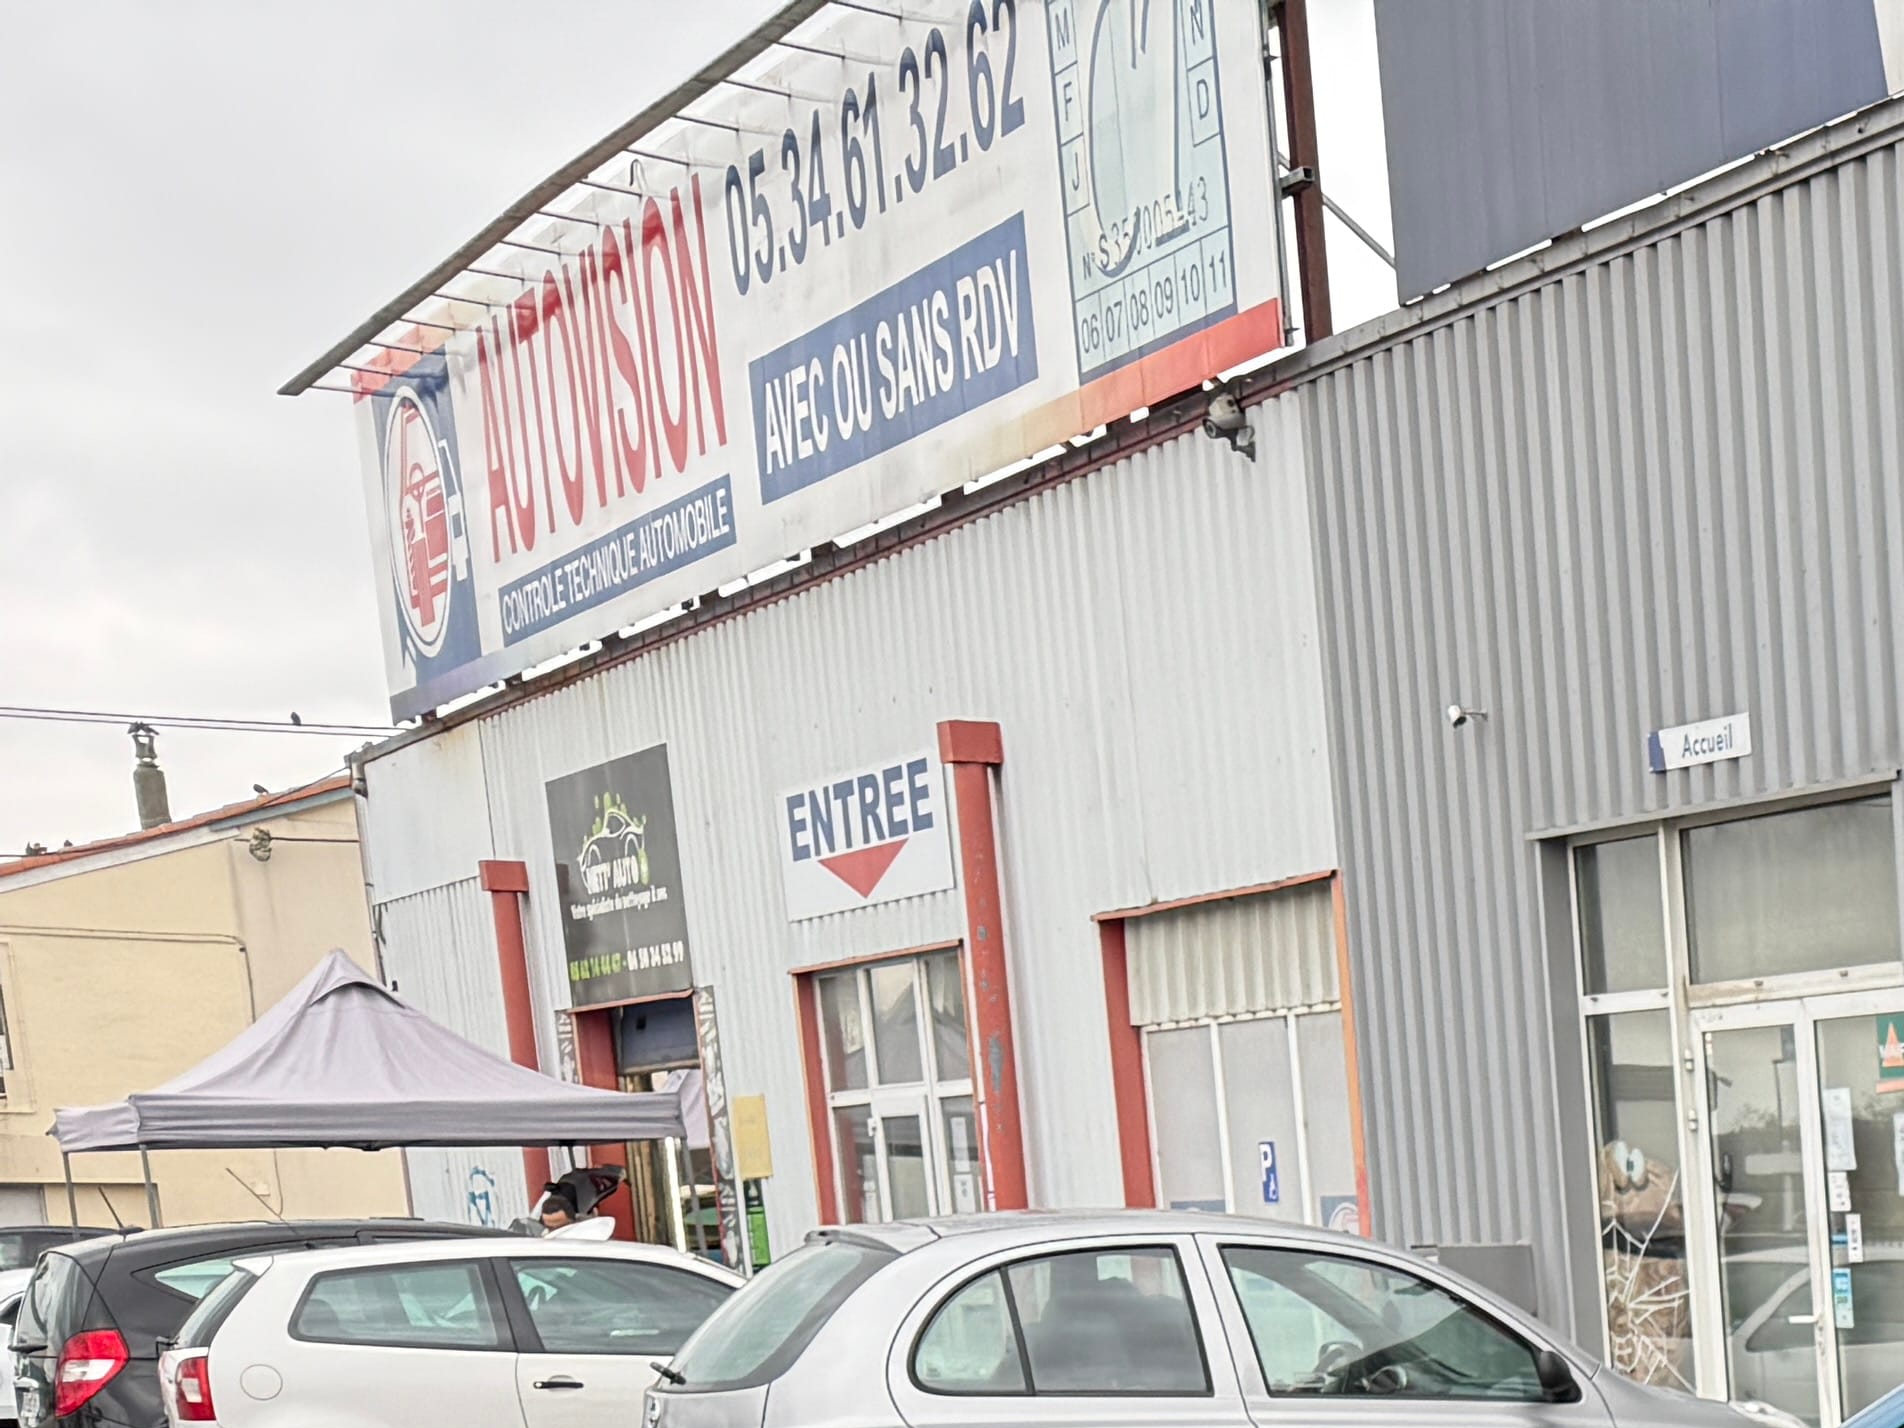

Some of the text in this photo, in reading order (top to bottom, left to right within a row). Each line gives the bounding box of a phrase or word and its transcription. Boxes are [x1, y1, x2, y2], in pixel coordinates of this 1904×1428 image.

[724, 0, 1025, 296] 05.34.61.32.62
[1063, 81, 1073, 123] F
[1196, 78, 1211, 121] D
[476, 172, 727, 564] AUTOVISION
[765, 250, 1020, 474] AVEC OU SANS RDV
[502, 489, 730, 634] CONTROLE TECHNIQUE AUTOMOBILE
[1681, 722, 1733, 758] Accueil
[786, 757, 934, 863] ENTREE
[1259, 1143, 1273, 1183] P
